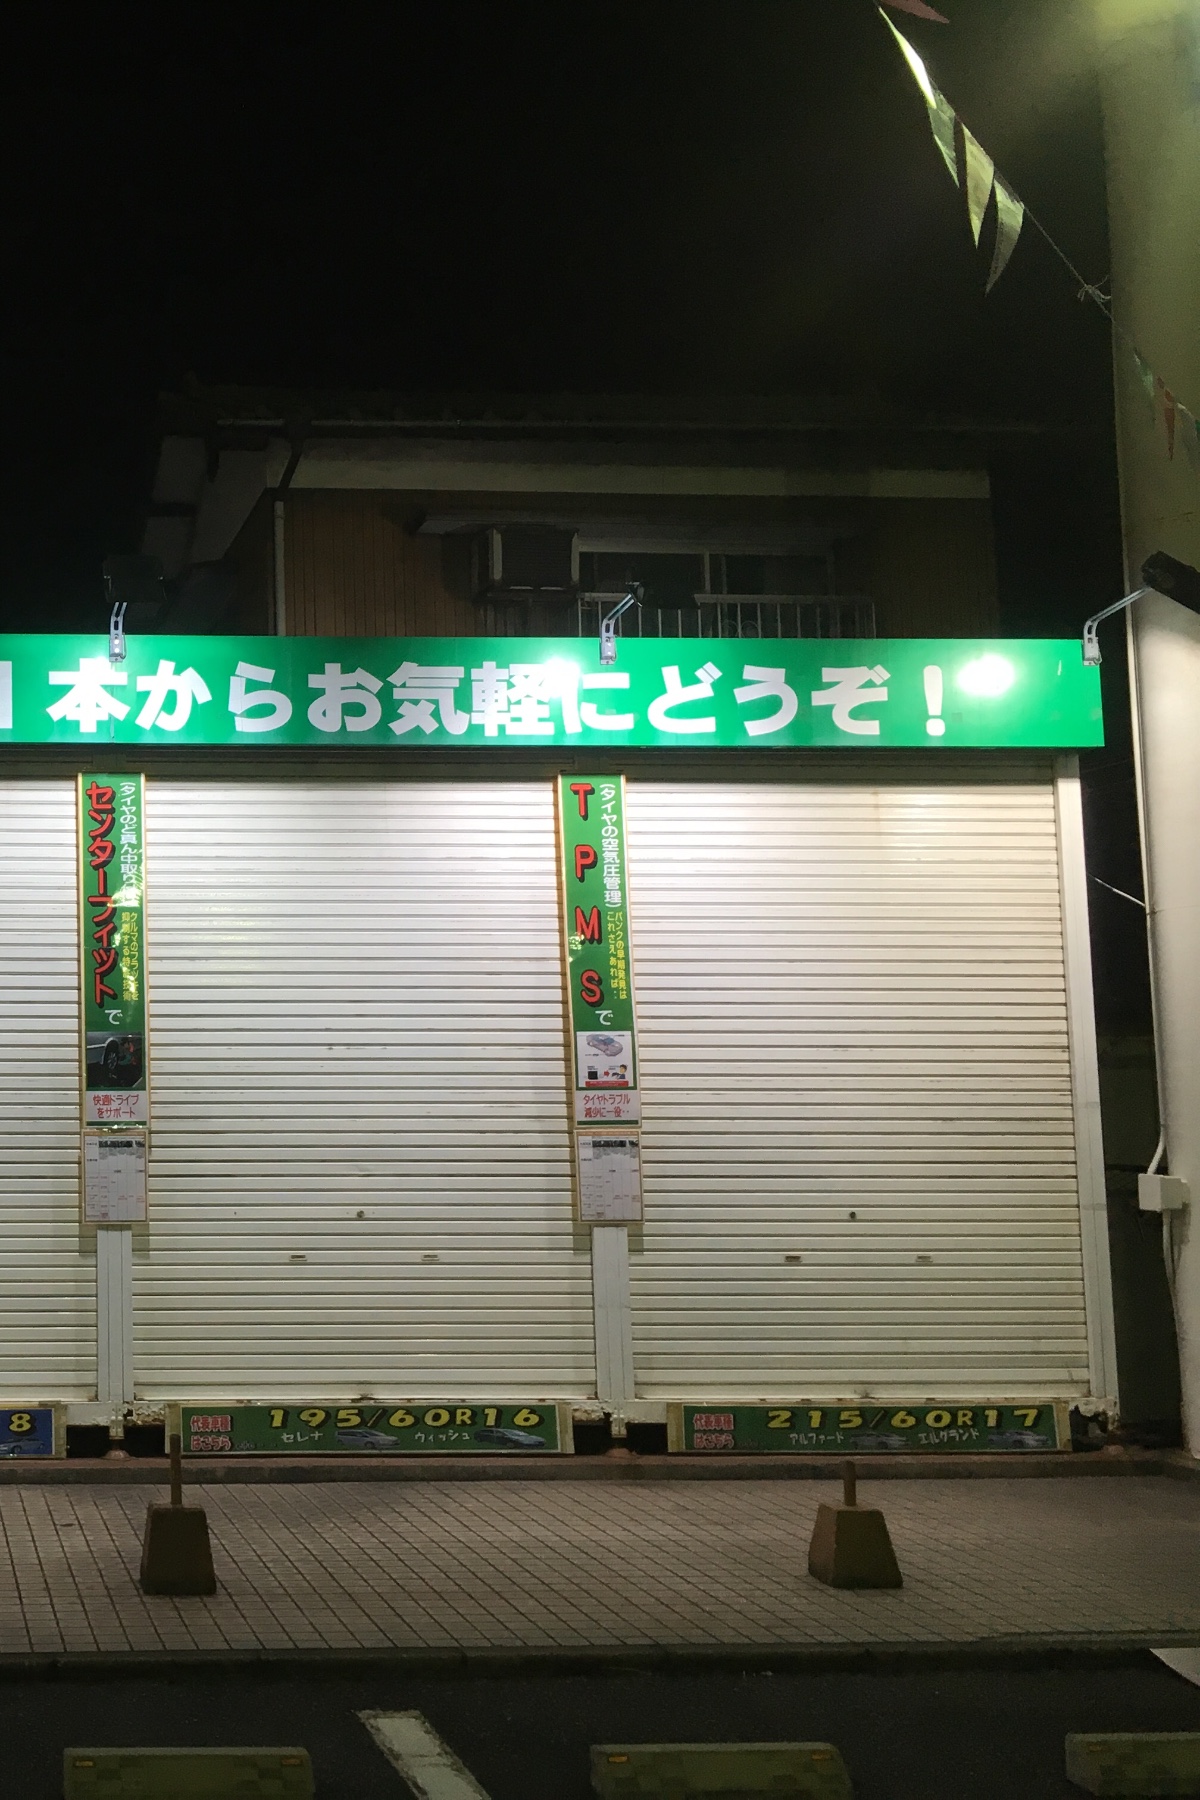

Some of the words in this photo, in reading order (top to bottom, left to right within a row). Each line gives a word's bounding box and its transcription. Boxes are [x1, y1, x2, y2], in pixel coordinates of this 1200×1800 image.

[93, 1094, 139, 1106] 快適ドライブ
[583, 1093, 631, 1106] タイヤトラブル
[97, 1107, 136, 1119] をサポート
[190, 1414, 231, 1432] 代表車種
[269, 1407, 540, 1428] 195/60R16
[693, 1413, 734, 1431] 代表車種
[767, 1408, 1039, 1429] 215/60R17
[190, 1435, 231, 1450] はこちら
[281, 1430, 324, 1443] セレナ
[414, 1429, 470, 1443] ウィッシュ
[693, 1433, 735, 1449] はこちら
[789, 1431, 844, 1445] アルファード
[918, 1428, 980, 1445] エルグランド
